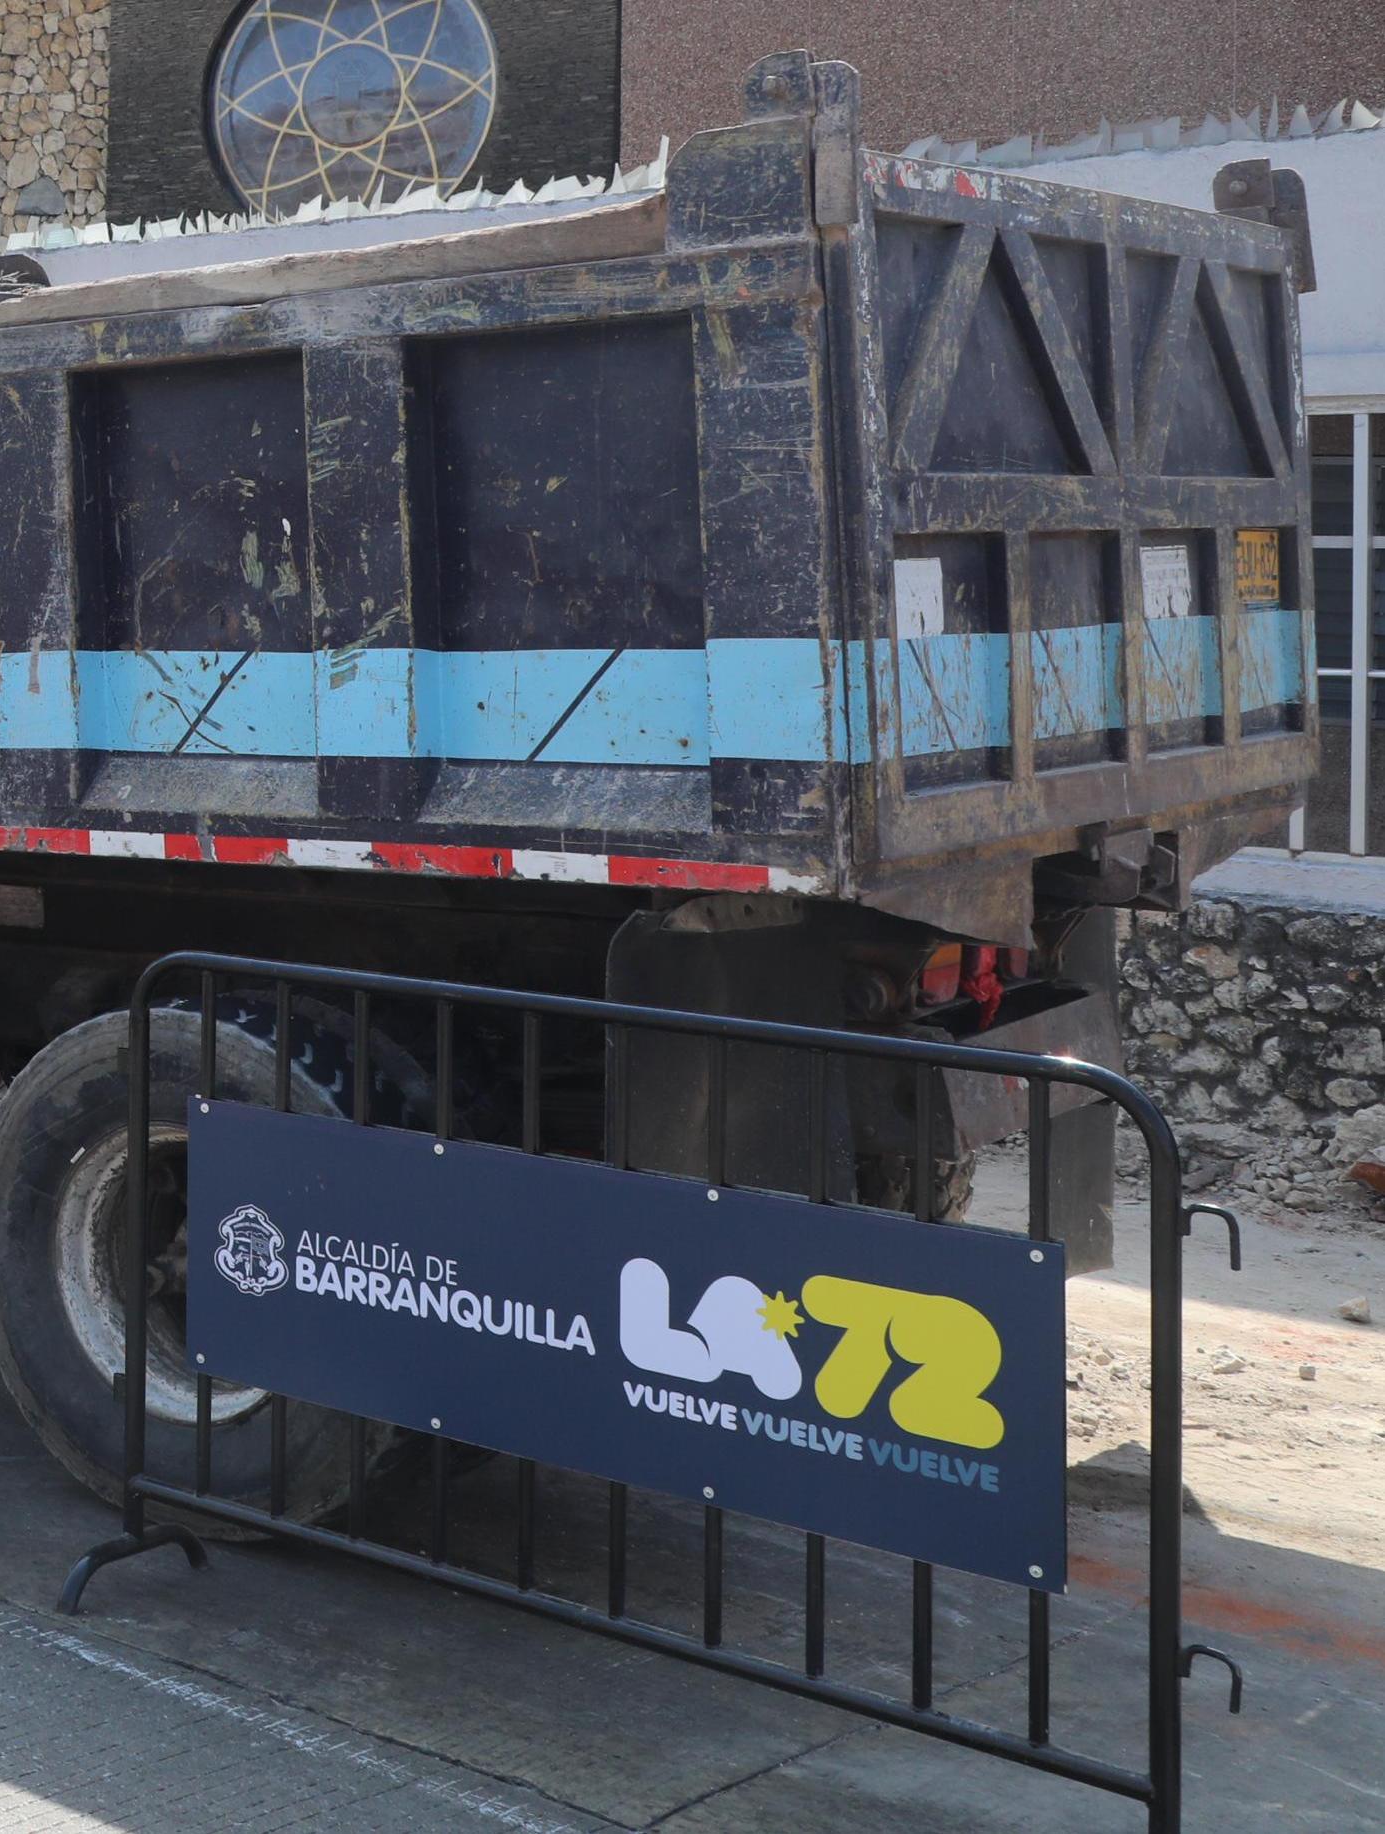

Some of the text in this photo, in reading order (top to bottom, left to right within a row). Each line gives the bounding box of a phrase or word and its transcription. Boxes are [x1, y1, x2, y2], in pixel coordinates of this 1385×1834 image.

[295, 1255, 596, 1356] BARRANQUILLA
[296, 1229, 458, 1286] ALCALDÍA DE
[622, 1380, 1000, 1493] VUELVE VUELVE VUELVE
